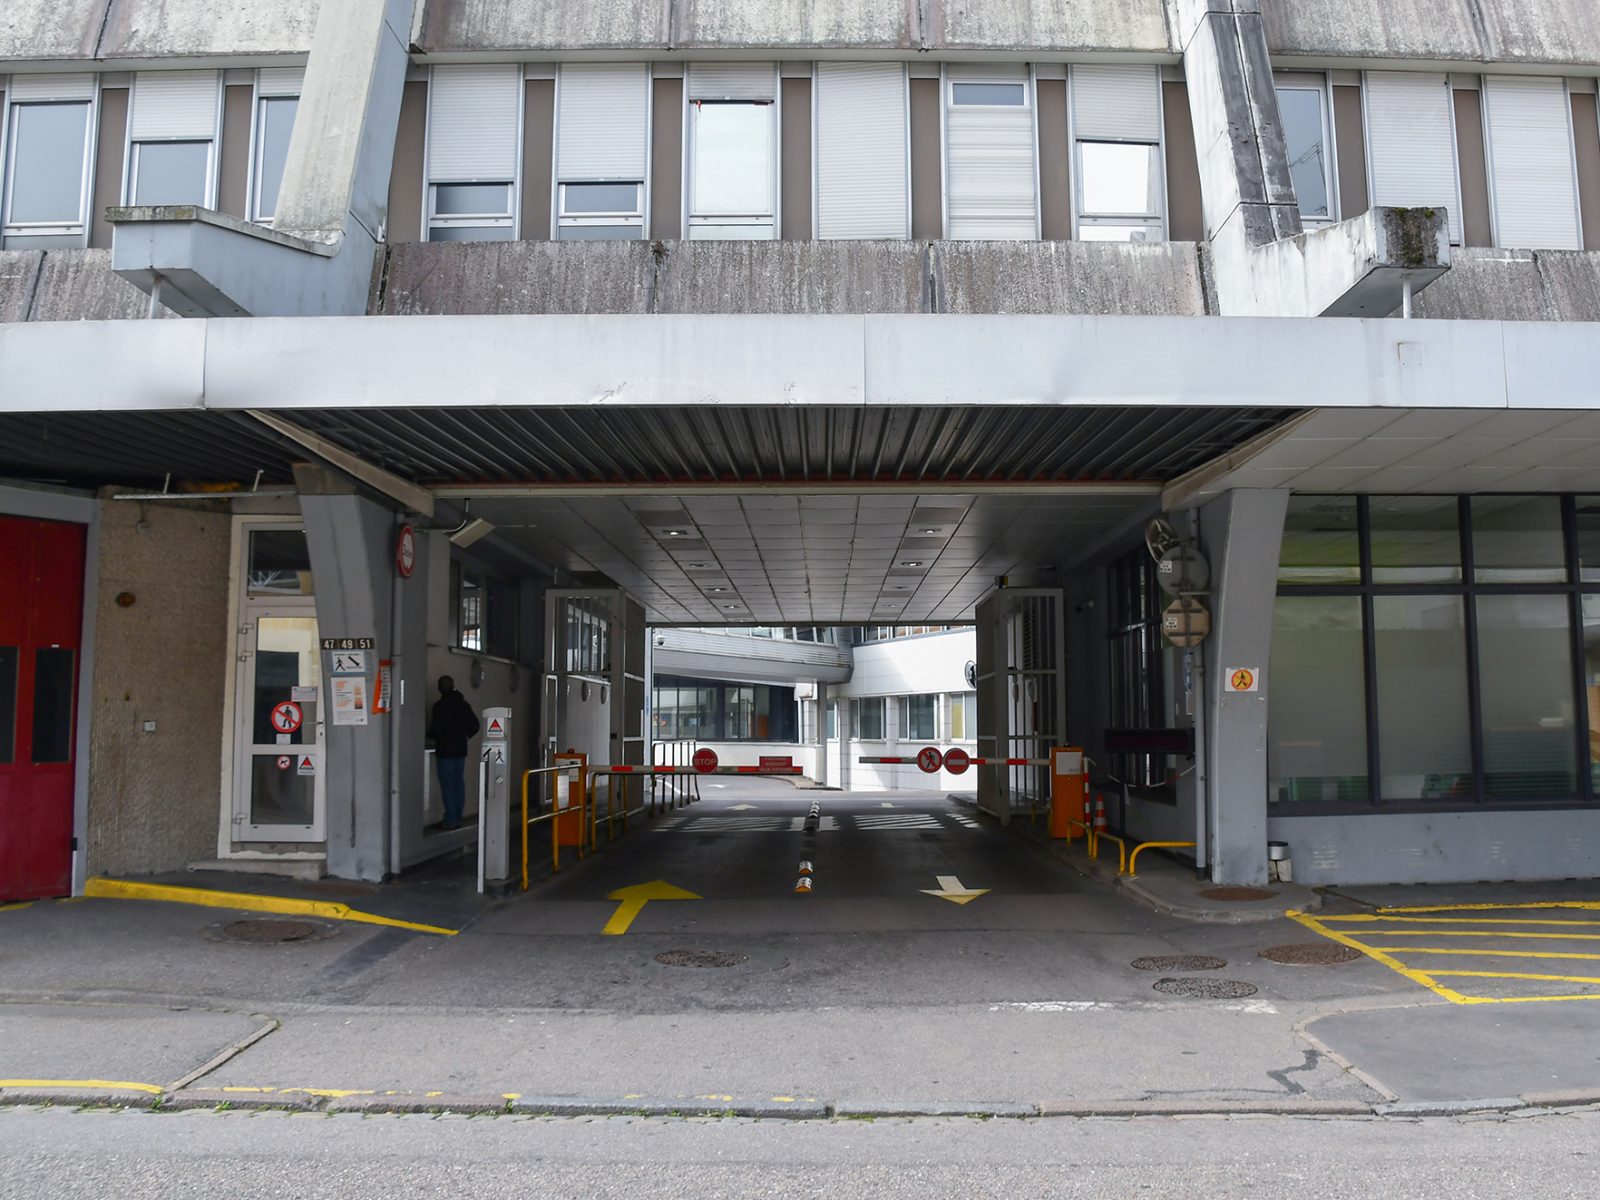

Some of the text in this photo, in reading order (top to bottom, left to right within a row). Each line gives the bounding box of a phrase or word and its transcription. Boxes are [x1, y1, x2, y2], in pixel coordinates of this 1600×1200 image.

[323, 638, 371, 649] 47 49 51
[694, 758, 716, 766] STOP
